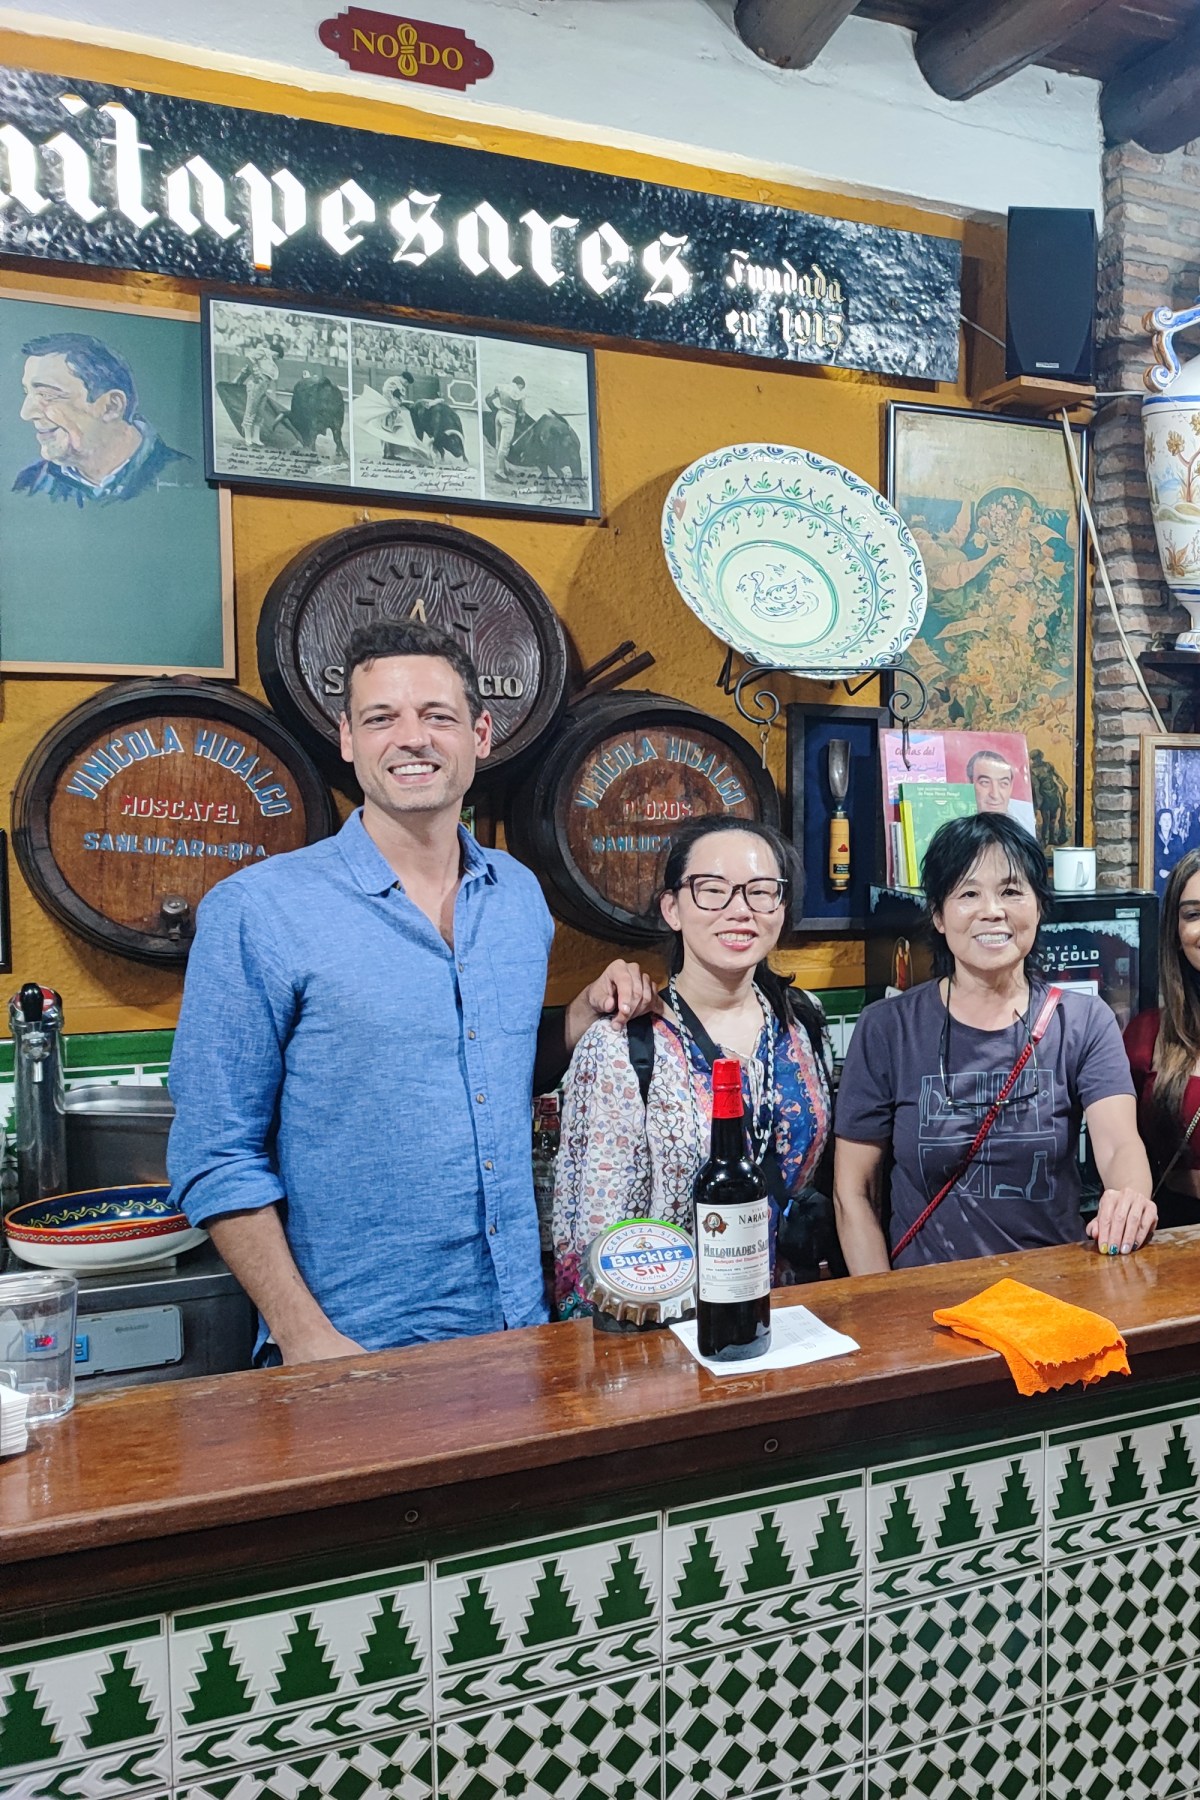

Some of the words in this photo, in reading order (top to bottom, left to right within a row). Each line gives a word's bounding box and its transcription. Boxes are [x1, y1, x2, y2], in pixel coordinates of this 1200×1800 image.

[725, 248, 847, 303] Fundada
[725, 309, 758, 338] en
[65, 725, 185, 800] VINICOLA
[120, 795, 240, 825] MOSCATEL
[82, 831, 204, 858] SANLUCAR
[1060, 949, 1100, 962] COLD
[606, 1227, 653, 1252] CERVEZA
[661, 1230, 679, 1243] SIN
[609, 1248, 683, 1268] Buckler
[610, 1271, 656, 1292] PREMIUM
[659, 1261, 690, 1290] QUALITY
